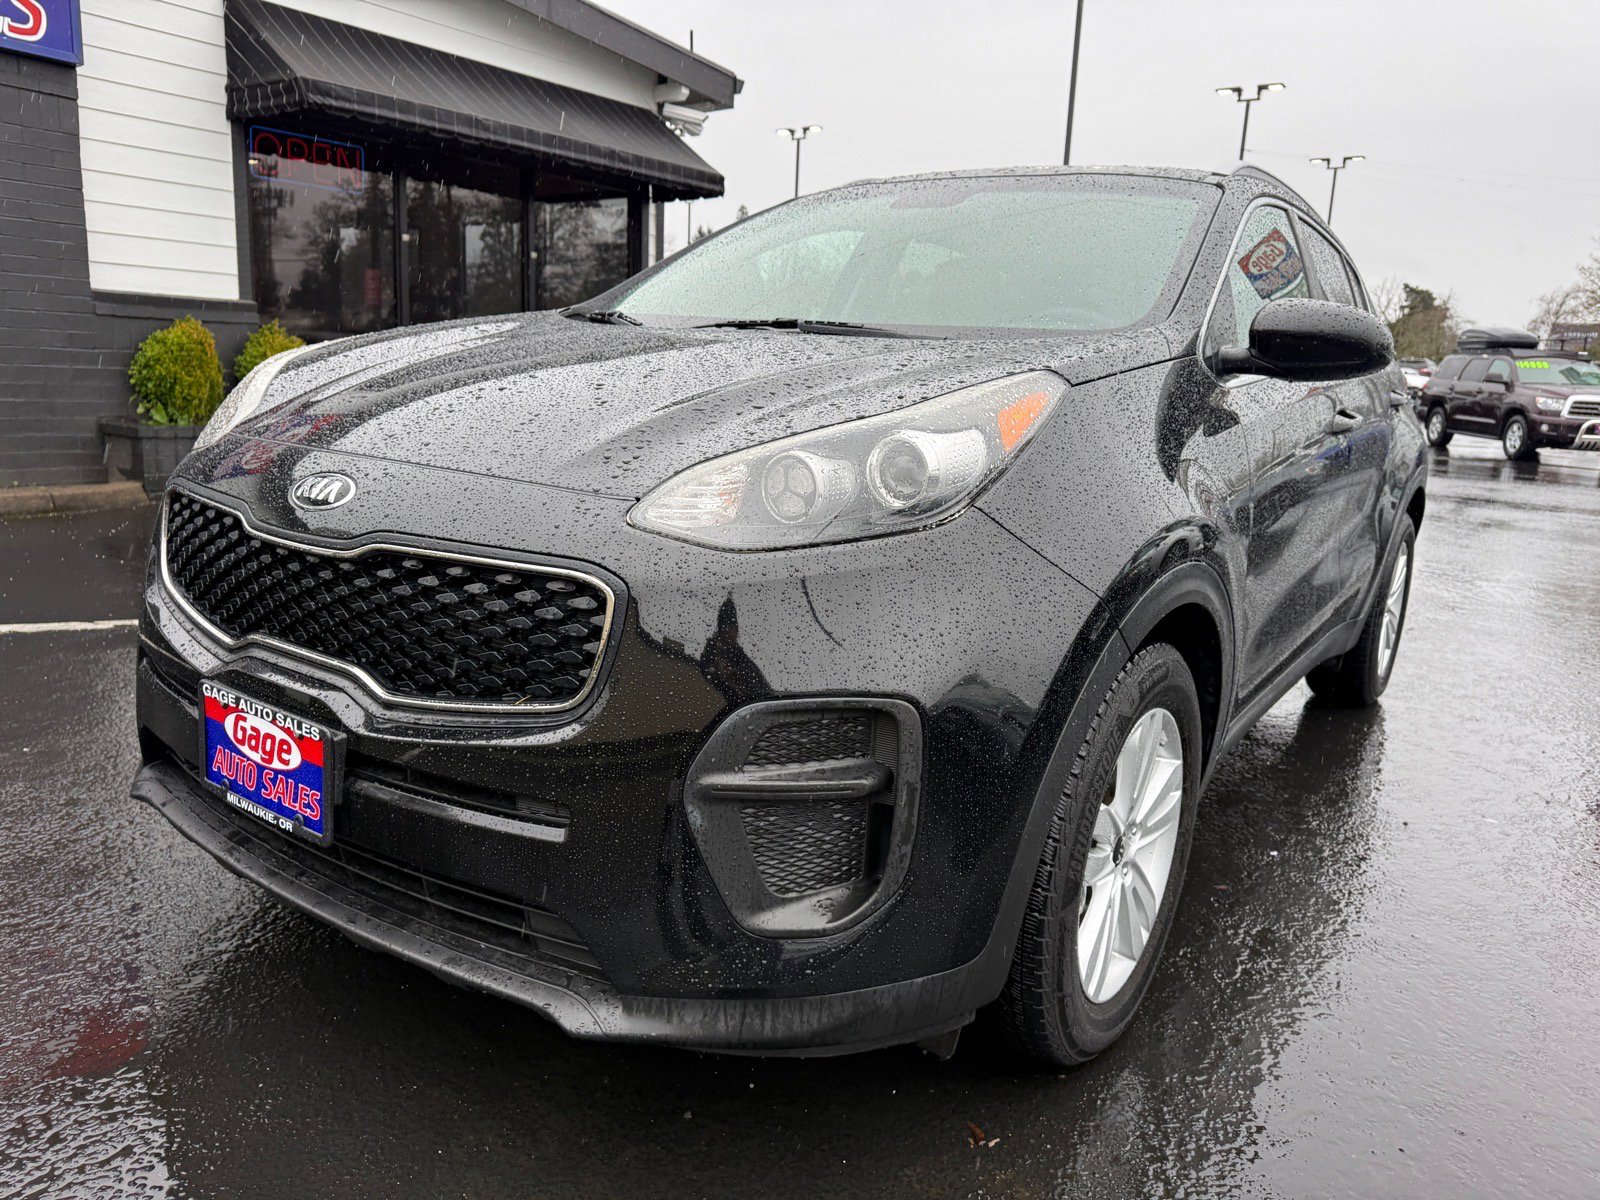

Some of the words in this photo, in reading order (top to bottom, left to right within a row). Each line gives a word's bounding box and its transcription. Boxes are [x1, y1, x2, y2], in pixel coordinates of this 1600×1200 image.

[255, 133, 362, 188] OPEN
[296, 477, 343, 503] KIA
[203, 684, 236, 707] GAGE
[238, 699, 273, 722] AUTO
[275, 713, 320, 741] SALES
[233, 714, 292, 766] Gage
[213, 745, 257, 791] AUTO
[261, 770, 321, 821] SALES
[227, 793, 276, 825] MILWAUKIE,
[279, 819, 293, 832] OR
